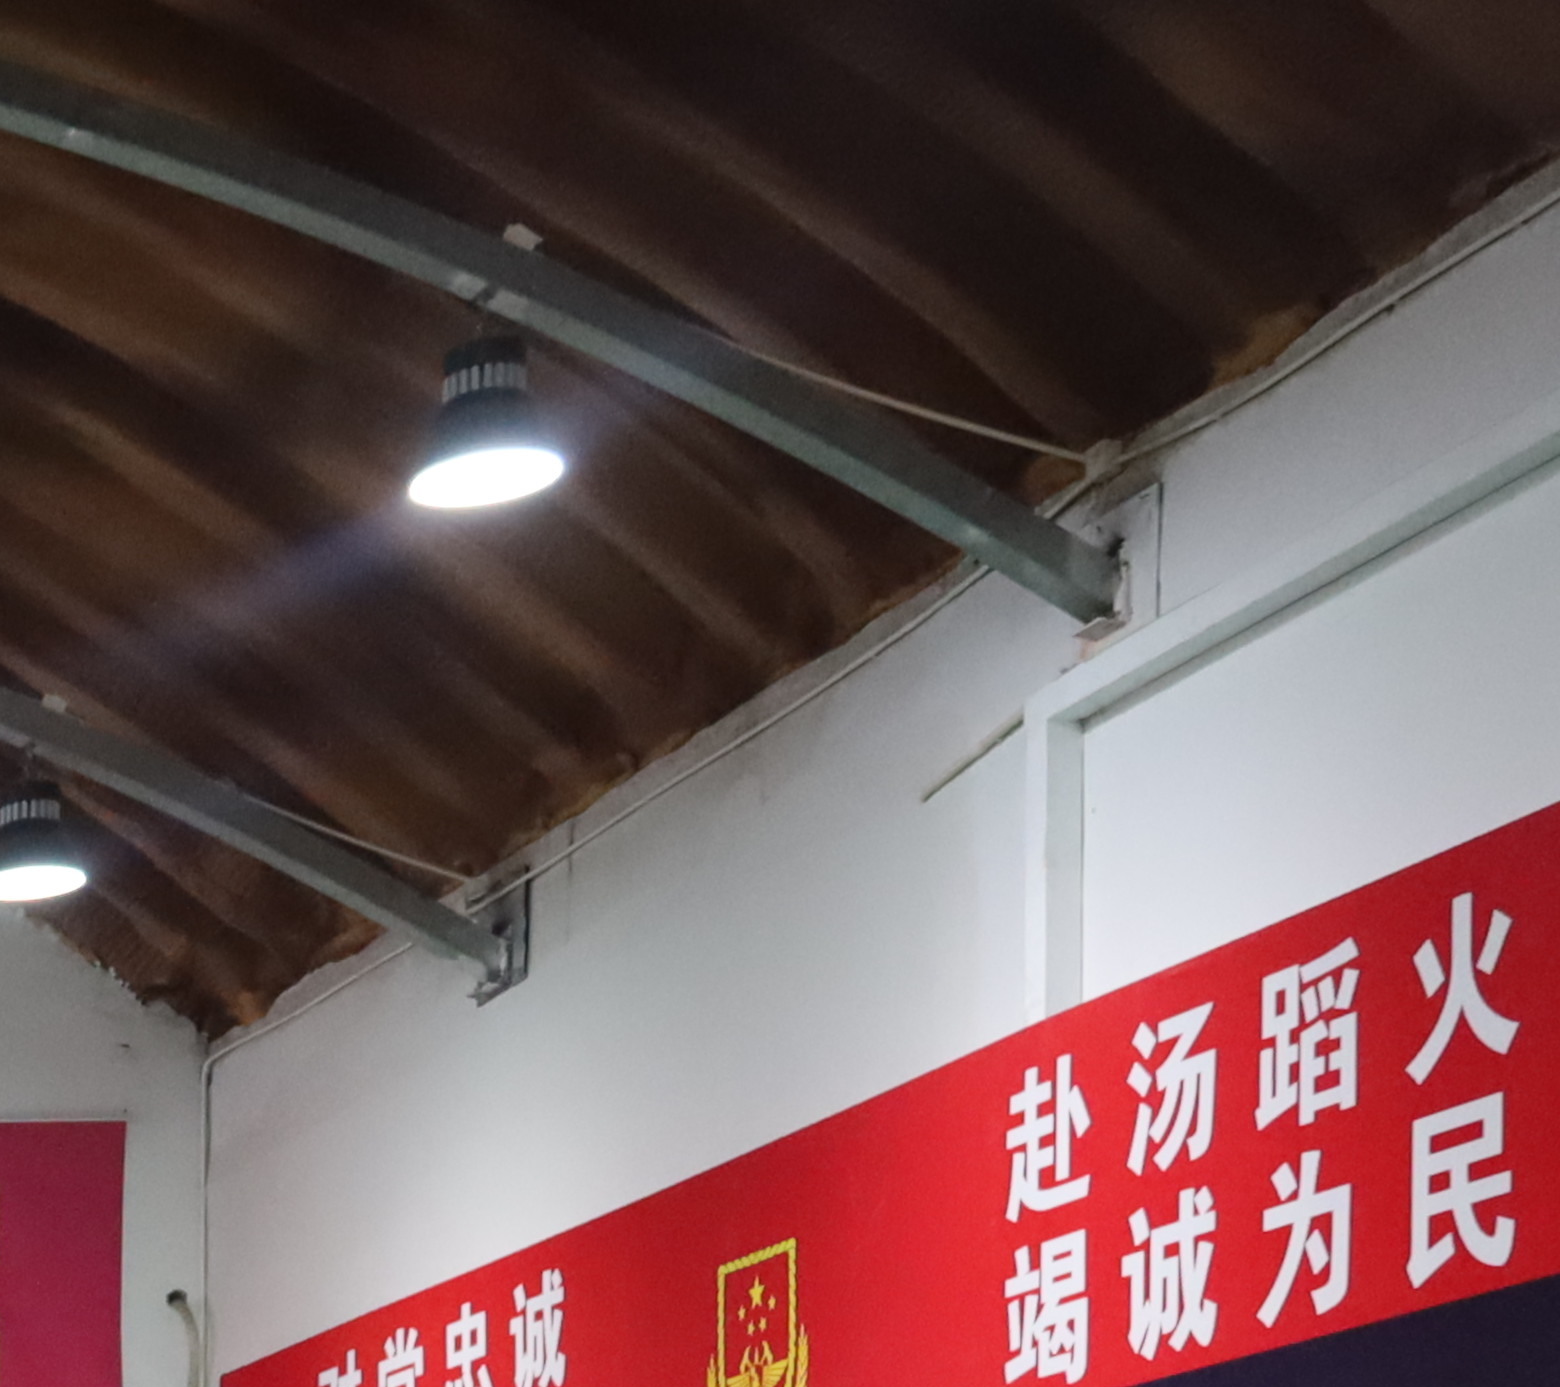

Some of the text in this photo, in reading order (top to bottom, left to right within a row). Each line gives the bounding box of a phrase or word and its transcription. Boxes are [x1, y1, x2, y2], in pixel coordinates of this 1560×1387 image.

[1006, 894, 1518, 1221] 赴汤蹈火
[1005, 1094, 1514, 1383] 竭诚为民
